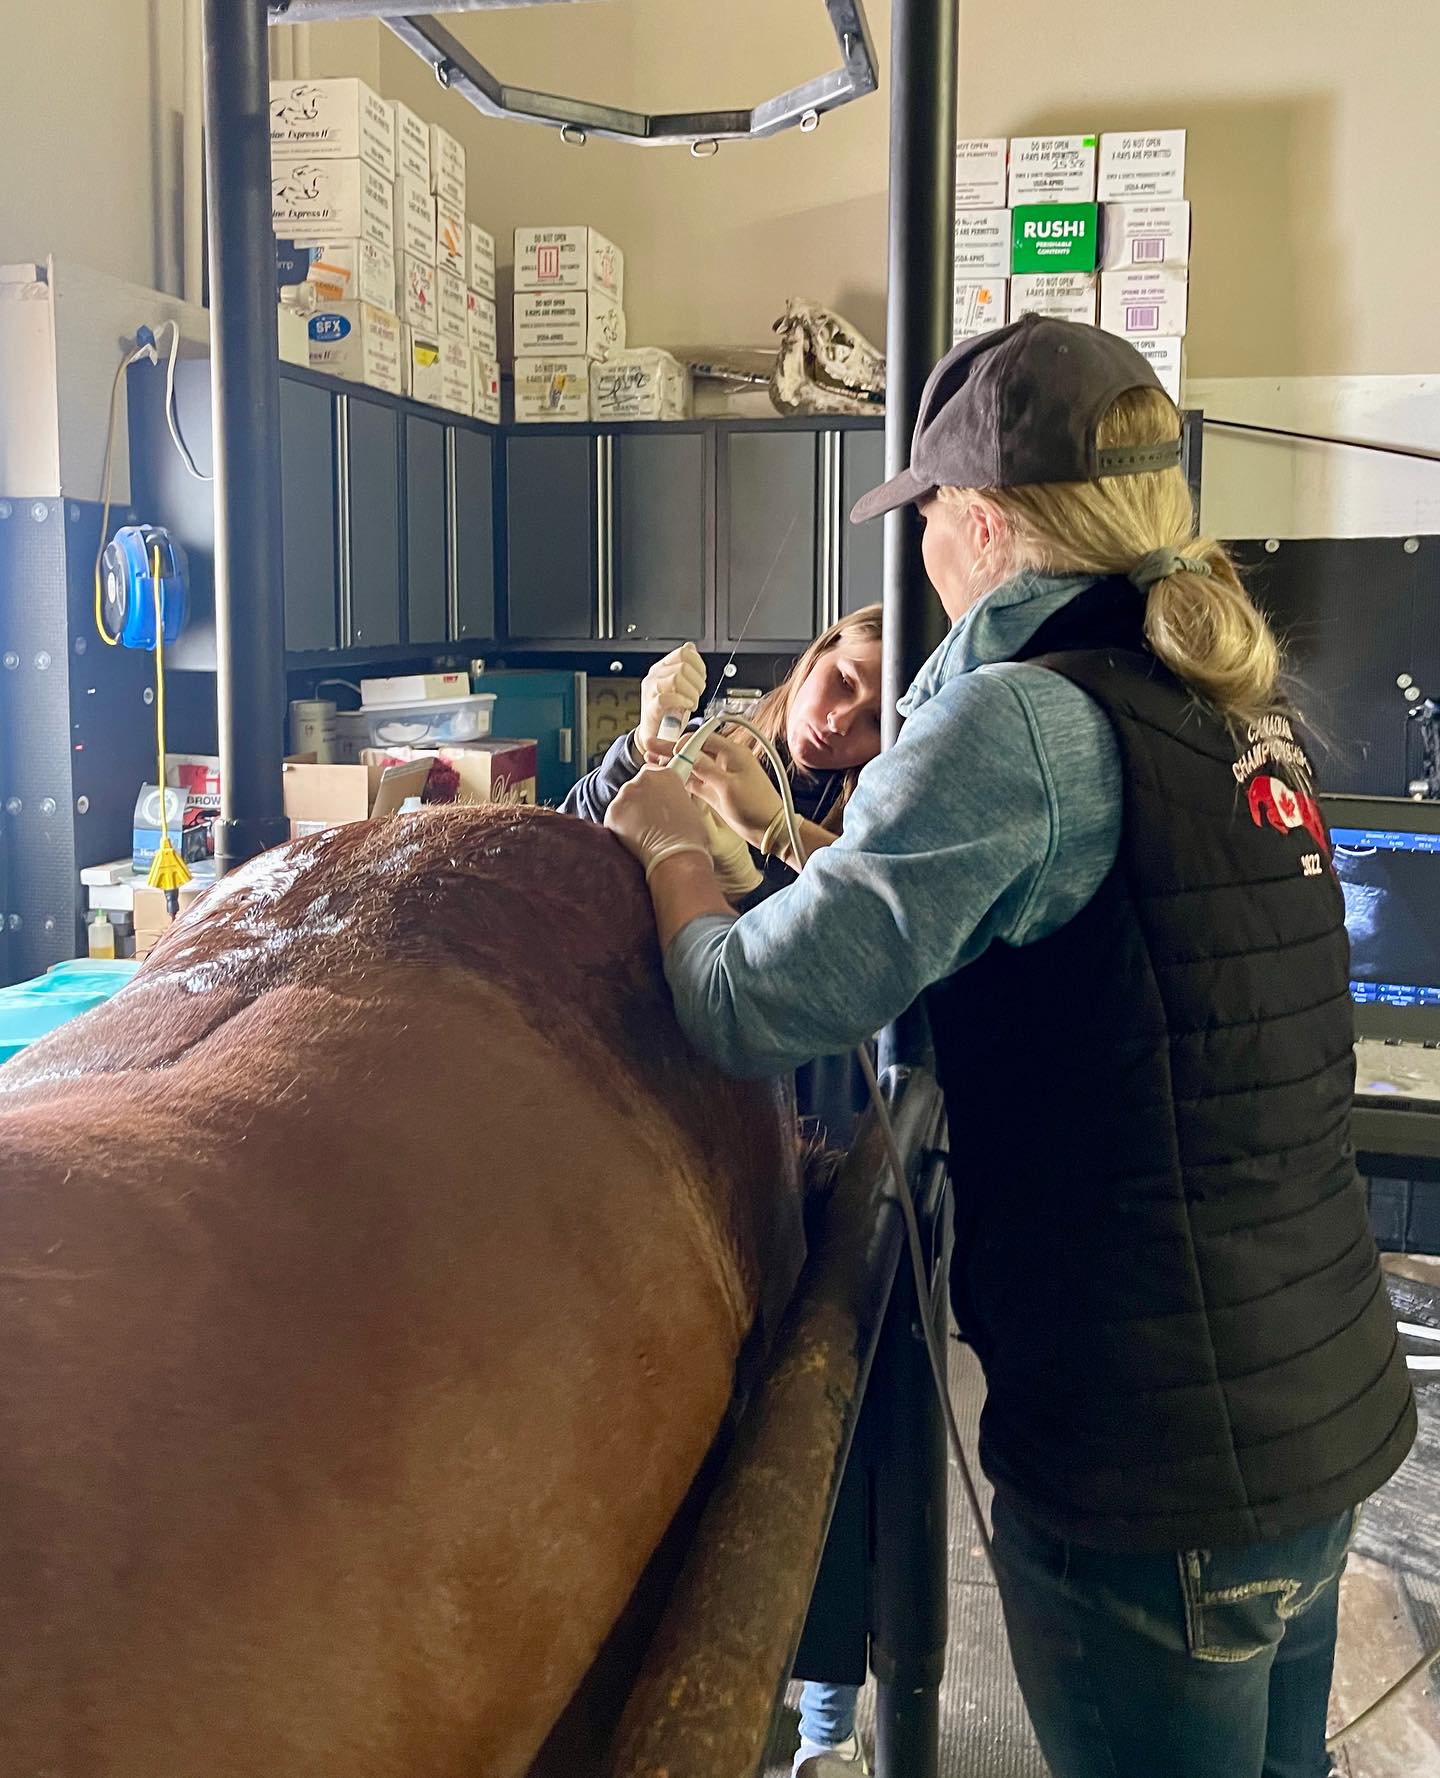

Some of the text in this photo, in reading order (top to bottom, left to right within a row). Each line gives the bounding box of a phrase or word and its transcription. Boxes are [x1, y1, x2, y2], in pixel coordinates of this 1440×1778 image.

[970, 142, 989, 150] OPEN
[1031, 140, 1070, 150] DO NOT OPEN
[1133, 139, 1144, 148] NOT
[1146, 138, 1162, 147] OPEN
[1041, 152, 1051, 160] ARE
[1052, 150, 1079, 160] PERMITTED
[1143, 149, 1171, 159] PERMITTED
[1024, 220, 1085, 238] RUSH!
[1036, 241, 1072, 249] PERISHABLE
[1036, 276, 1074, 287] DO NOT OPEN
[1056, 288, 1084, 297] PERMITTED
[553, 299, 565, 307] OPEN
[551, 308, 576, 316] PERMITTED
[1140, 341, 1155, 349] OPEN
[186, 795, 221, 805] BROW
